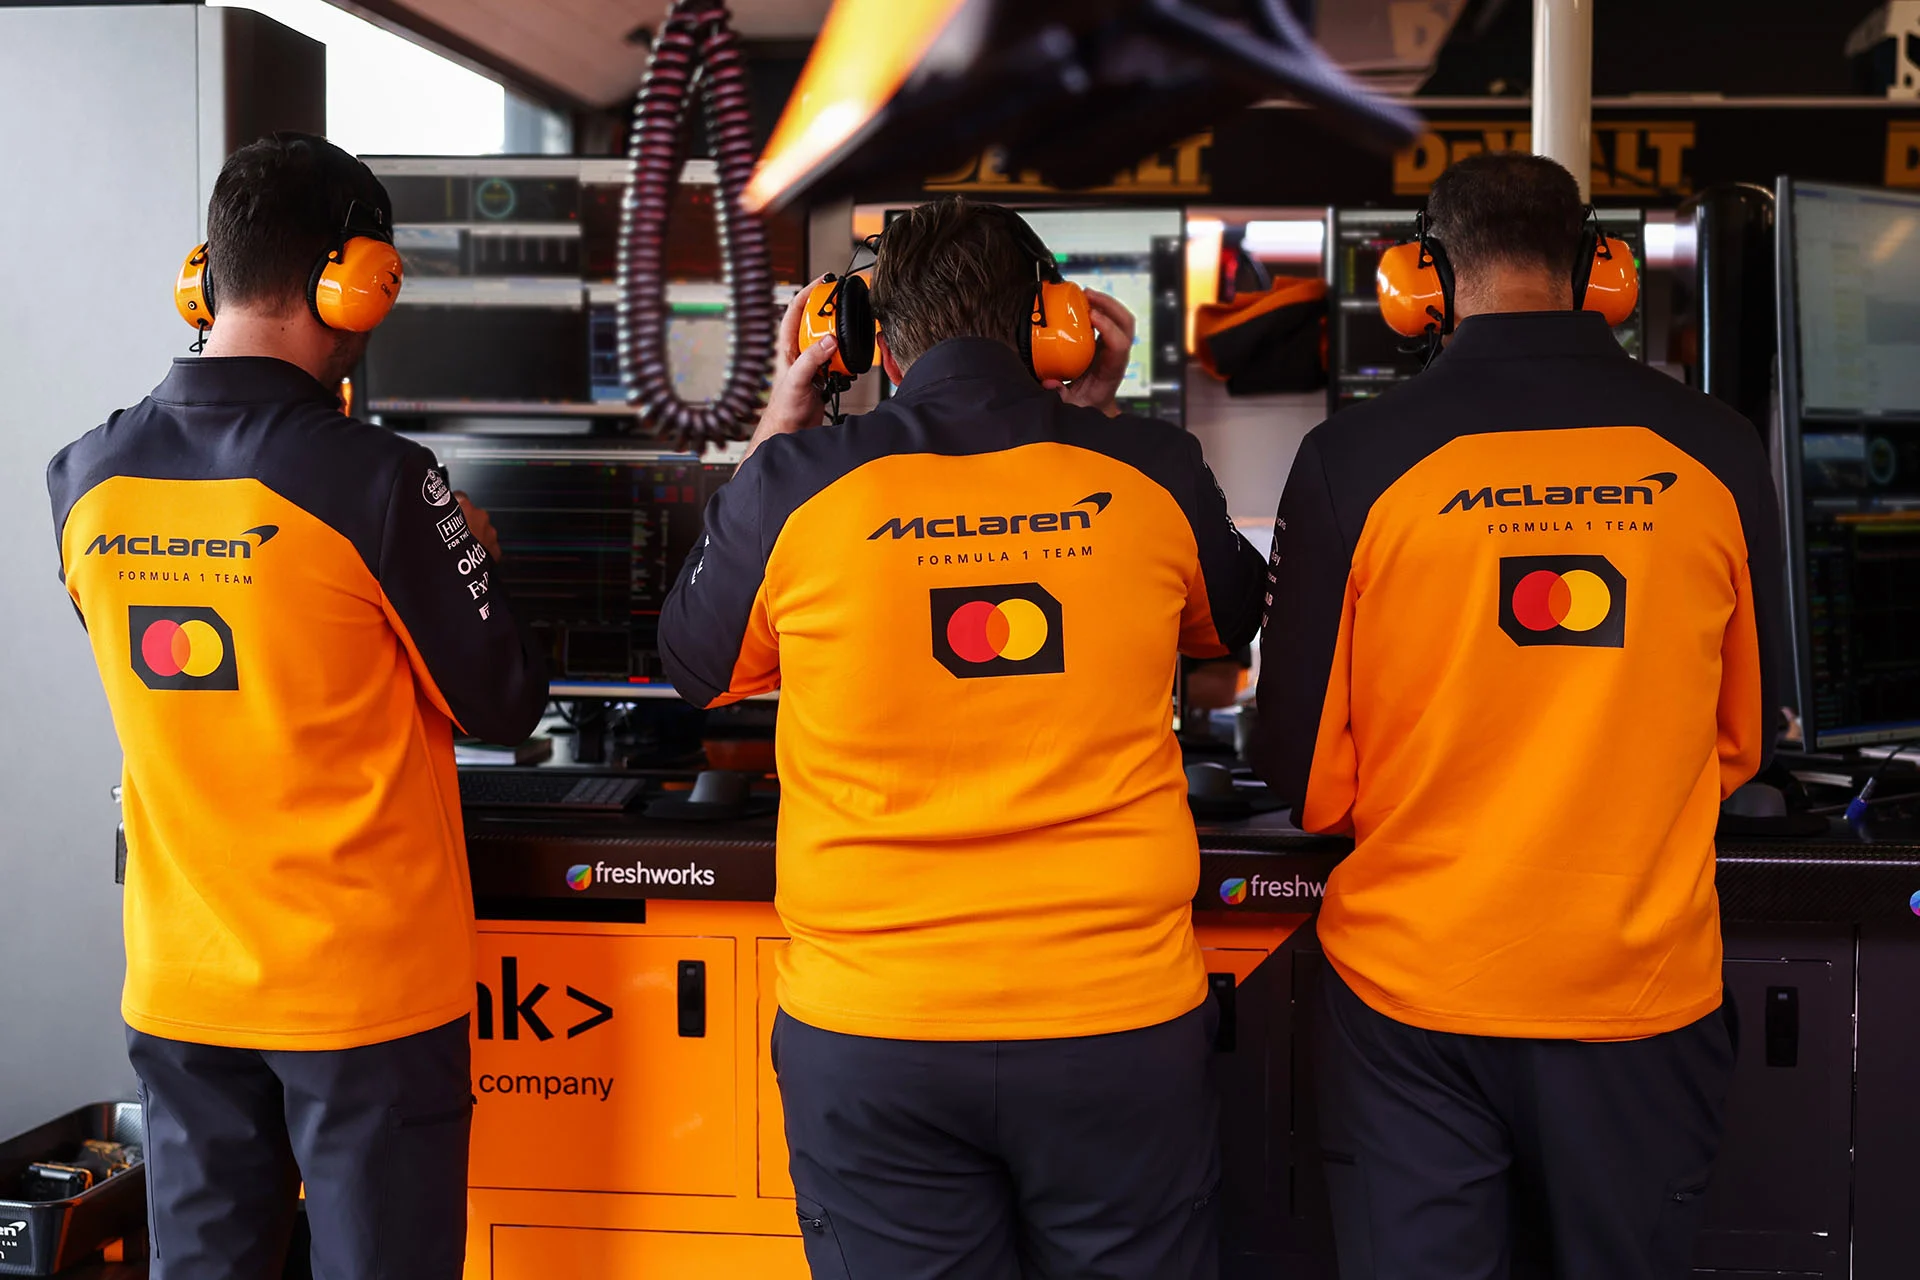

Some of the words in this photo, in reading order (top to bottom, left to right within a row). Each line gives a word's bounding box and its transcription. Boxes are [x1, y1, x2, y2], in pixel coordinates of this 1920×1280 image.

[1438, 484, 1653, 515] McLaren
[866, 509, 1091, 541] McLaren
[1488, 520, 1574, 534] FORMULA
[1586, 521, 1593, 531] 1
[1606, 520, 1655, 532] TEAM
[84, 534, 252, 559] McLaren
[447, 538, 461, 551] FOR
[918, 551, 1010, 566] FORMULA
[1022, 550, 1029, 560] 1
[1043, 545, 1094, 560] TEAM
[119, 570, 190, 582] FORMULA
[199, 573, 206, 583] 1
[215, 573, 253, 585] TEAM
[595, 861, 715, 886] freshworks
[479, 1073, 614, 1101] company
